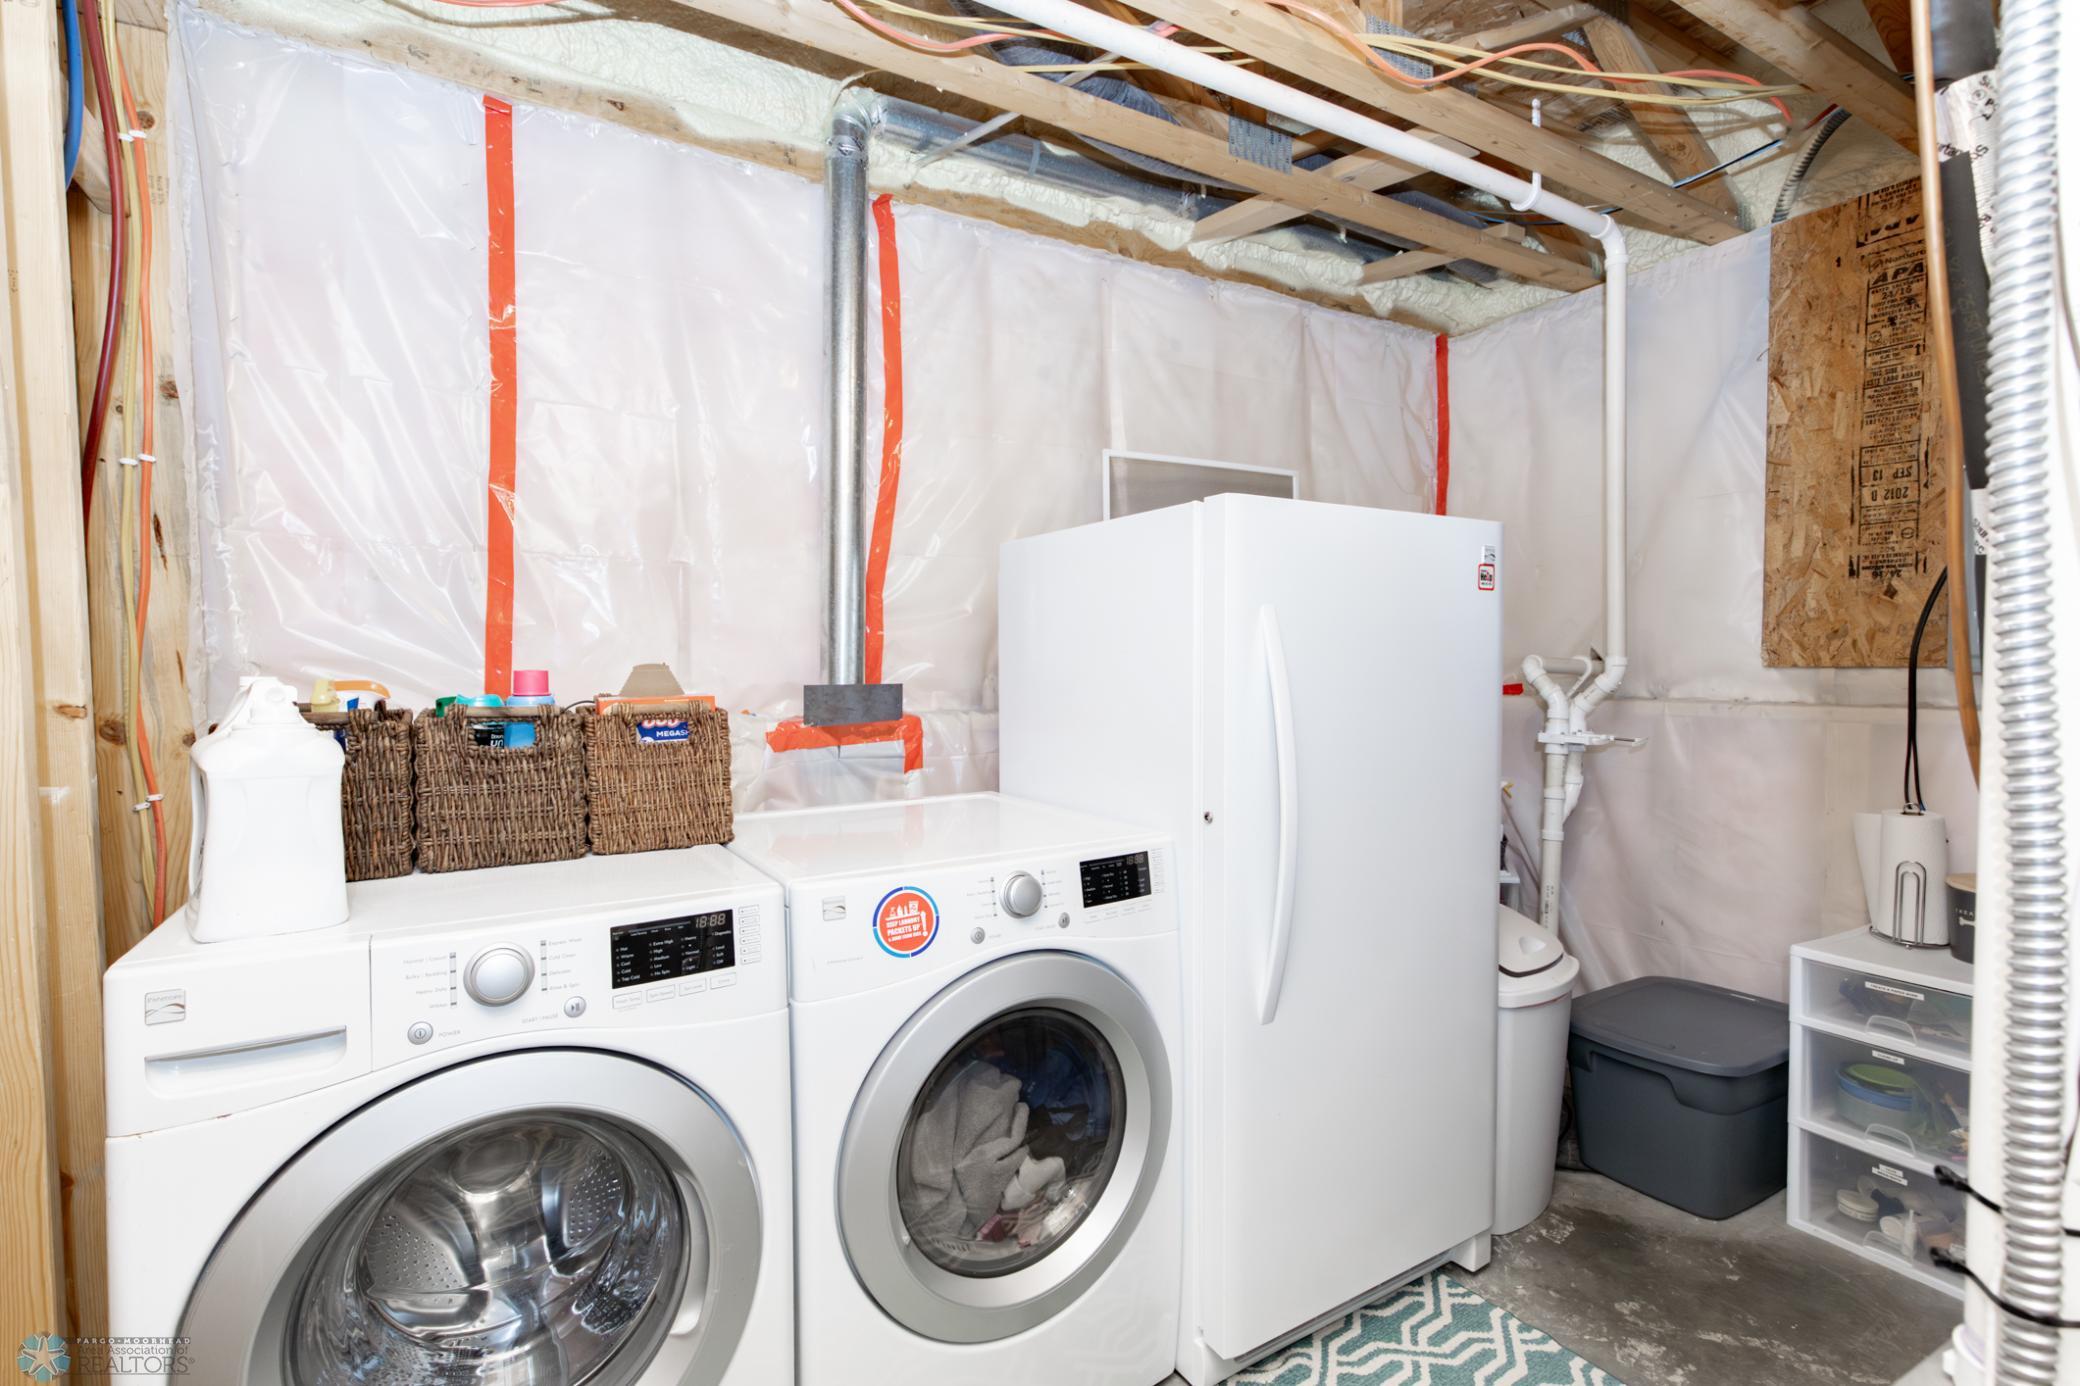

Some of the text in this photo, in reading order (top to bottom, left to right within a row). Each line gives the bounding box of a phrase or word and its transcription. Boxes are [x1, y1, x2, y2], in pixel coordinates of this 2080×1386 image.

[1871, 262, 1924, 286] APA
[1892, 466, 1913, 480] SEP
[1883, 487, 1909, 501] 2012
